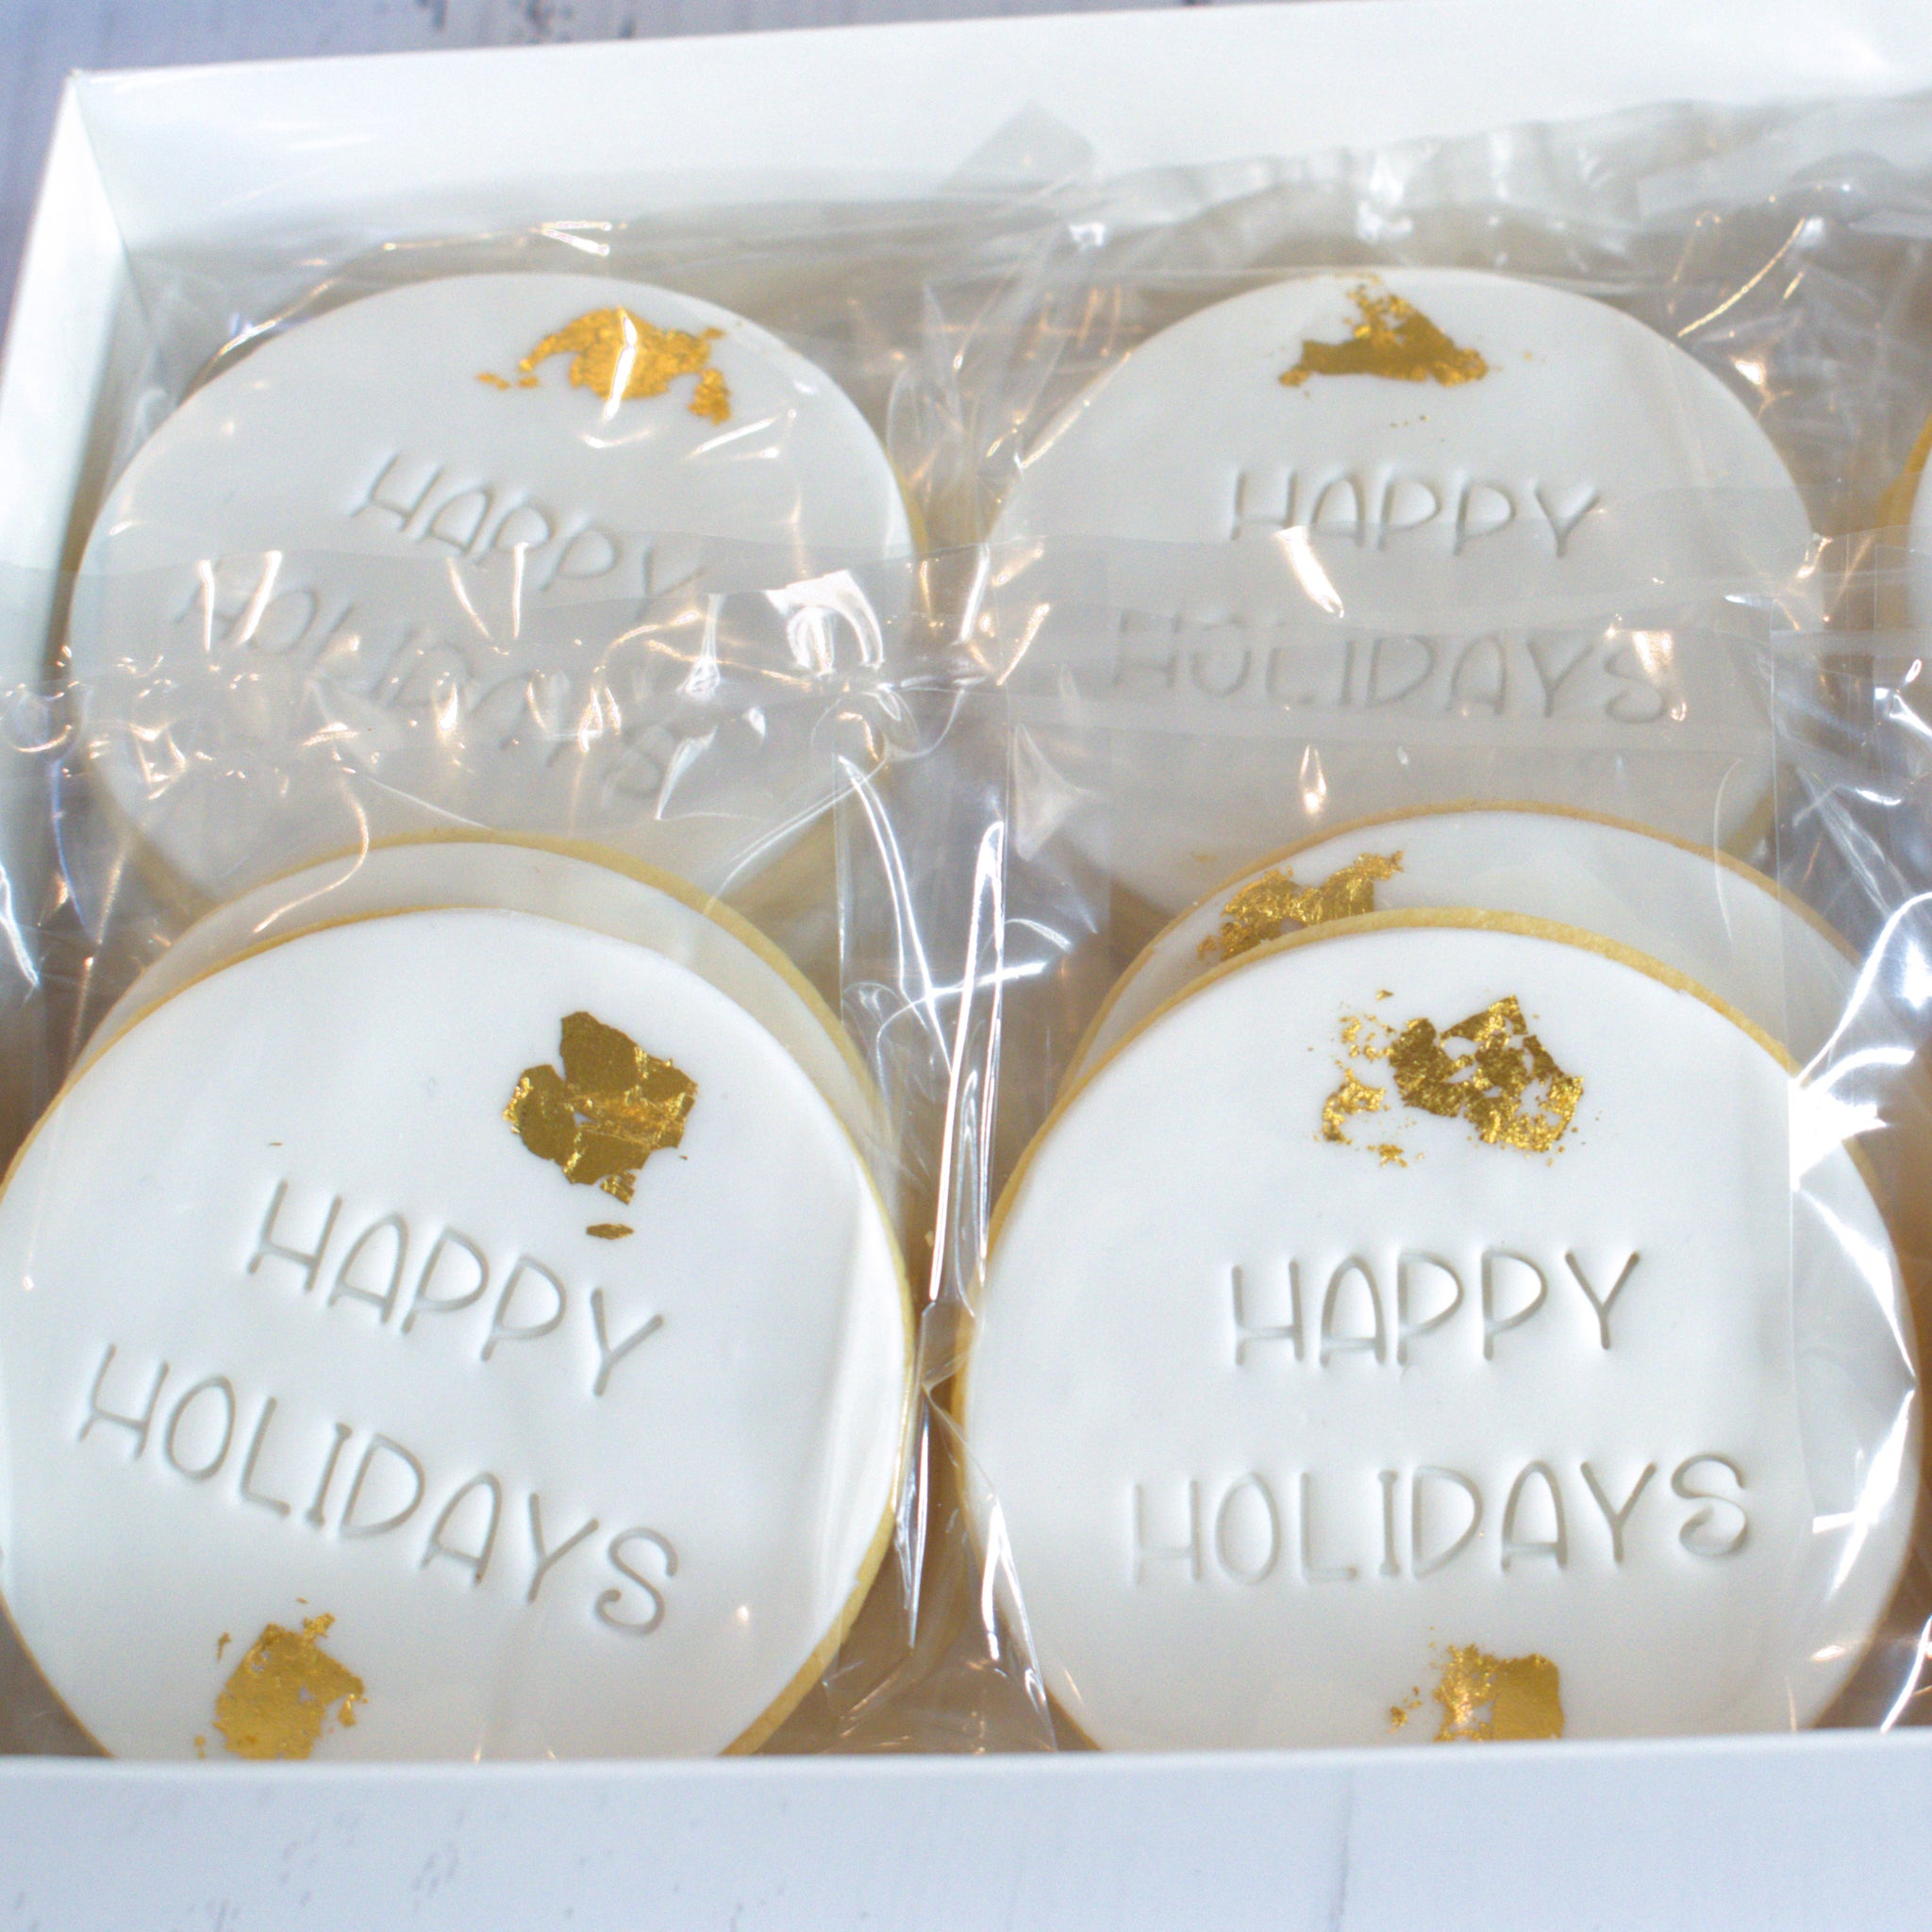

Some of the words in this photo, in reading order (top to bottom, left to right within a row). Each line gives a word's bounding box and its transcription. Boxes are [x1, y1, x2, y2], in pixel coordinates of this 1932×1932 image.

[348, 451, 707, 624] HAPPY
[1229, 469, 1602, 559] HAPPY
[173, 558, 683, 797] HOLIDAS
[1113, 608, 1672, 724] HOLIDAYS
[246, 1176, 666, 1397] HAPPY
[1230, 1248, 1641, 1367] HAPPY
[76, 1341, 679, 1637] HOLIDAYS
[1133, 1451, 1751, 1586] HOLIDAYS
